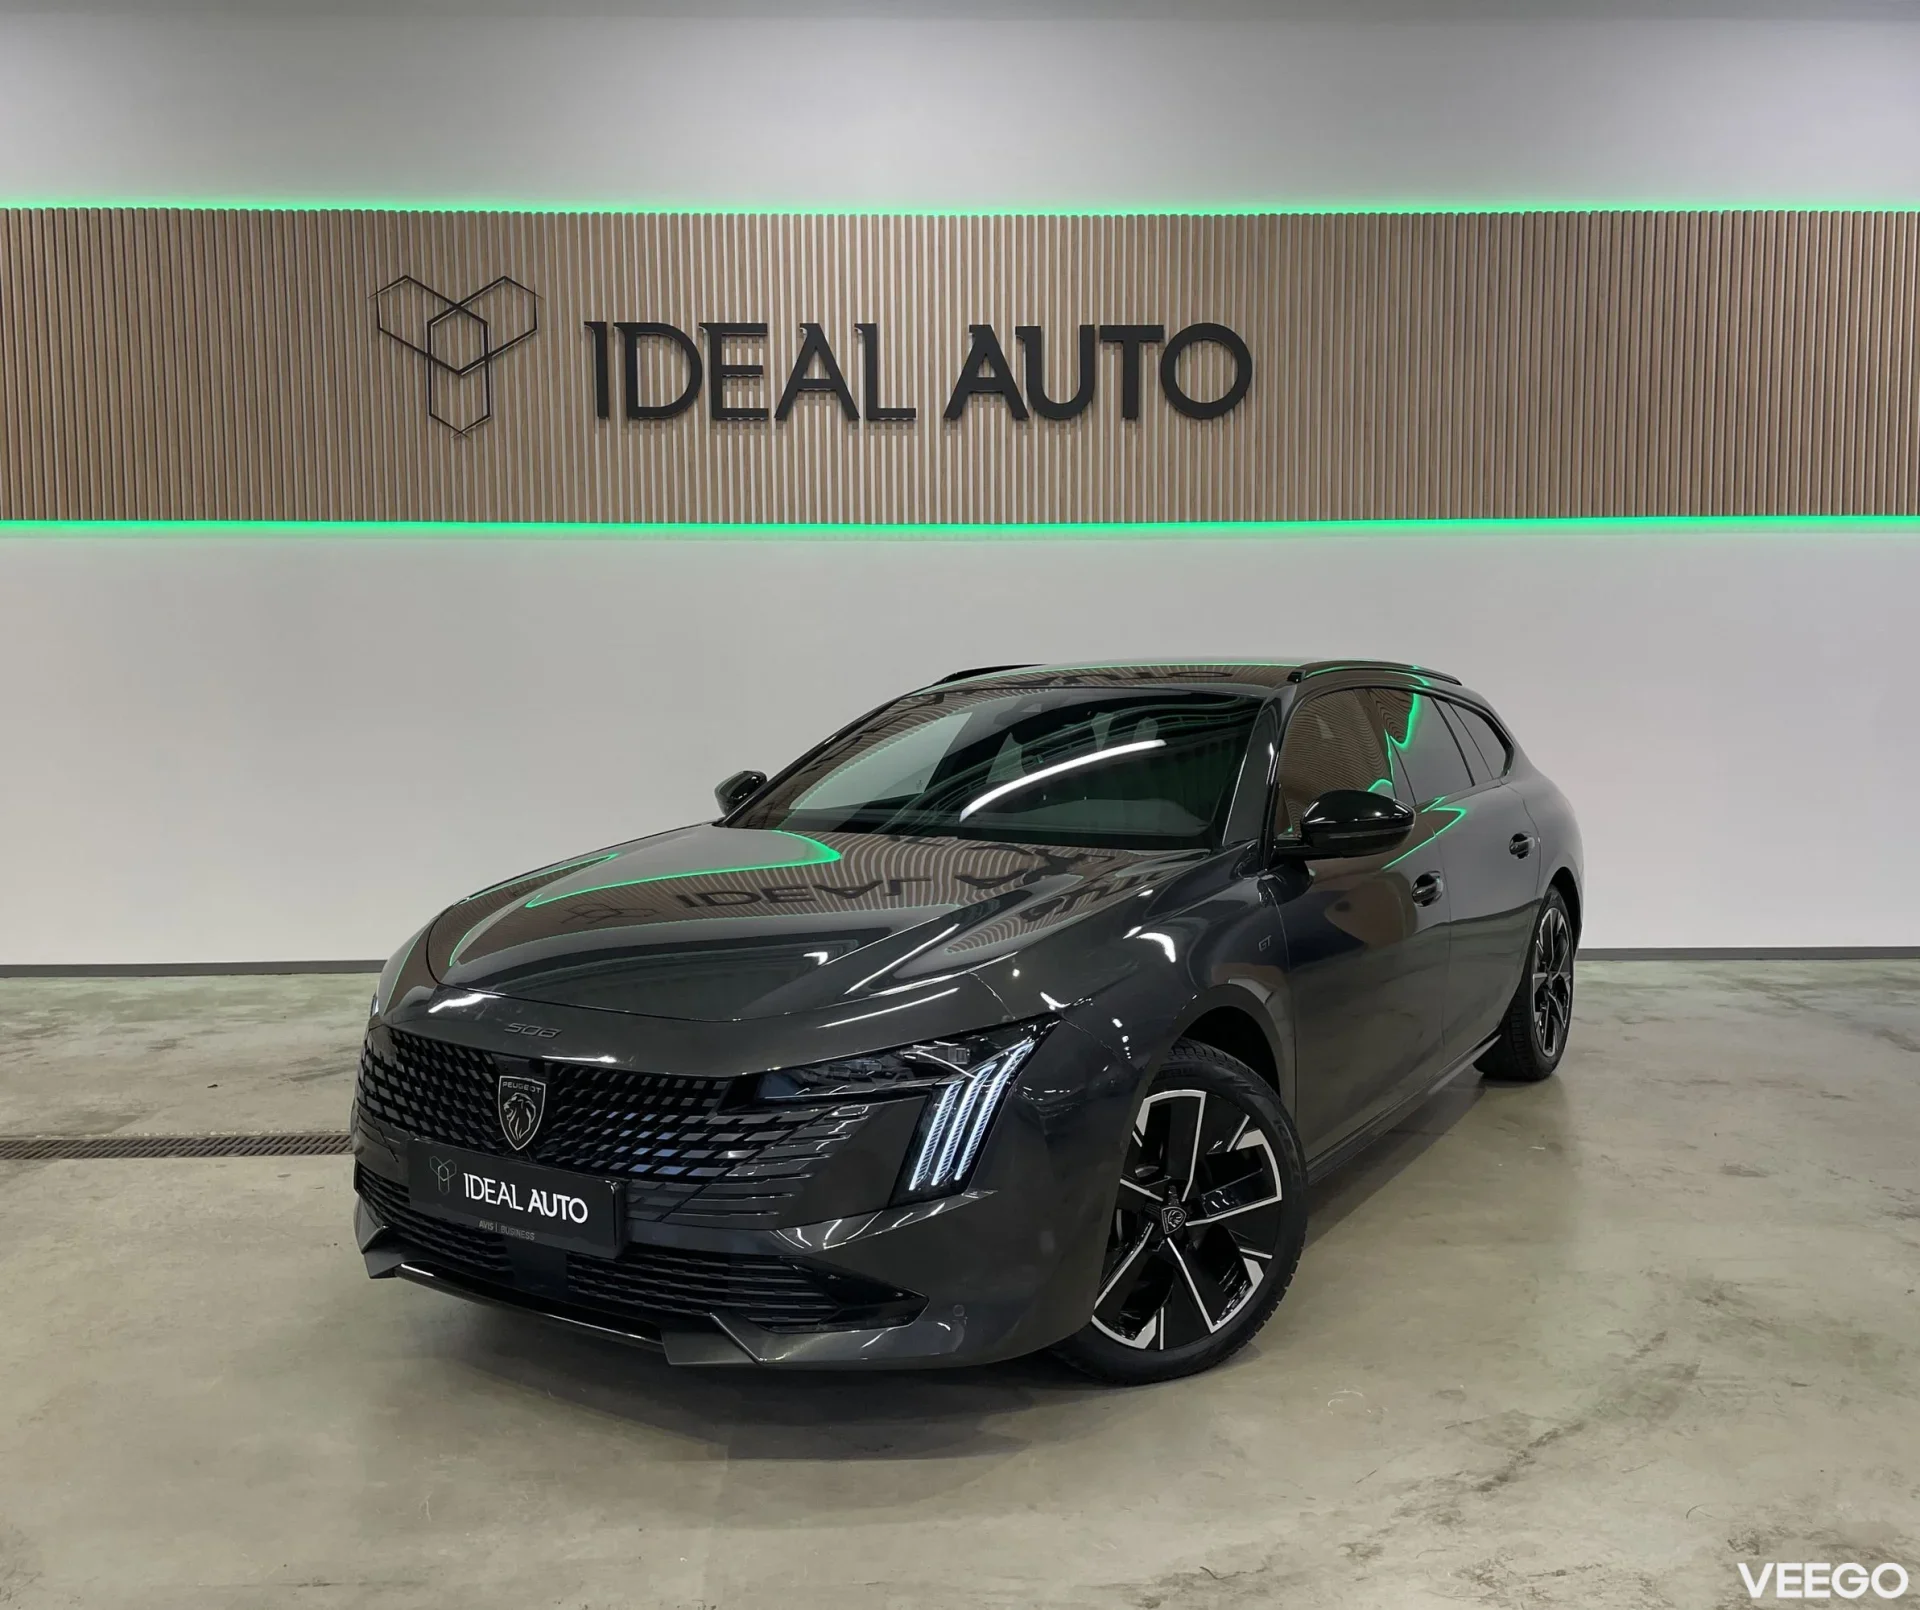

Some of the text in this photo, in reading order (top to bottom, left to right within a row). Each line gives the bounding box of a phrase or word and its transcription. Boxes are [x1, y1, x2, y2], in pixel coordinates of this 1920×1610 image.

[583, 321, 1253, 421] IDEAL AUTO
[1259, 935, 1271, 951] GT
[504, 1023, 562, 1038] 508
[502, 1081, 542, 1093] PEUGEOT
[463, 1172, 589, 1224] IDEAL AUTO
[479, 1220, 535, 1240] AVIS BUSINESS
